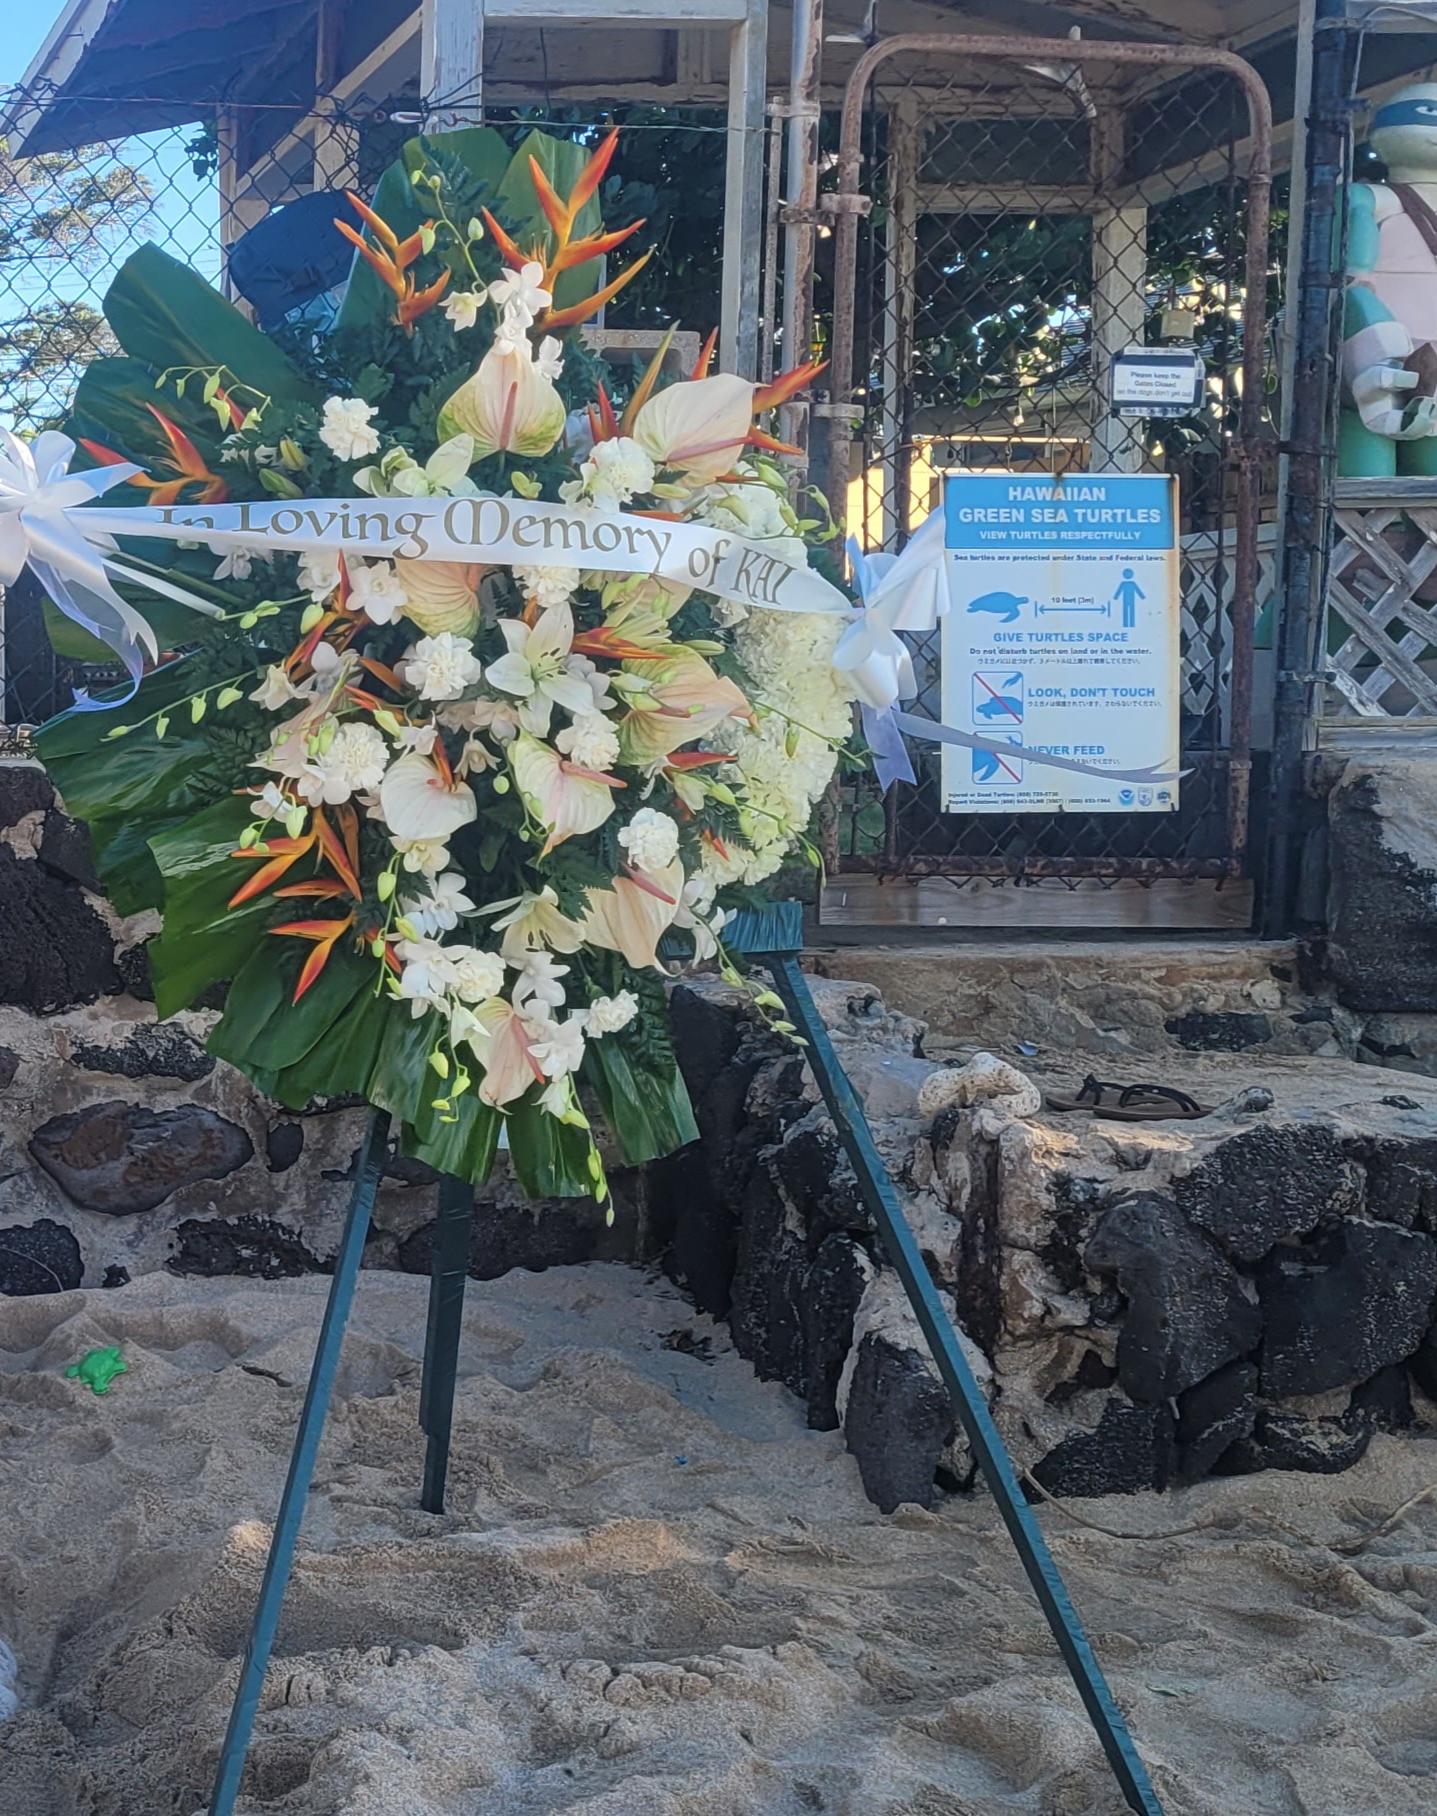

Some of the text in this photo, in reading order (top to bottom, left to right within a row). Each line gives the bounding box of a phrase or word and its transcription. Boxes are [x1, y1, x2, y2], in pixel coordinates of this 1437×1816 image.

[1009, 486, 1107, 501] HAWAIIAN
[958, 508, 1162, 524] GREEN SEA TURTLES
[979, 530, 1142, 541] VIEW TURTLES RESPECTFULLY
[231, 502, 437, 561] Loving
[443, 498, 672, 574] Memory
[687, 537, 732, 588] of
[730, 546, 798, 606] KAI
[1012, 554, 1051, 562] protected
[1052, 554, 1075, 562] under
[1076, 554, 1097, 562] State
[1099, 554, 1113, 562] and
[1115, 554, 1144, 562] Federal
[993, 632, 1129, 642] GIVE TURTLES SPACE
[1028, 688, 1155, 699] LOOK, DON'T TOUCH
[1028, 746, 1105, 756] NEVER FEED
